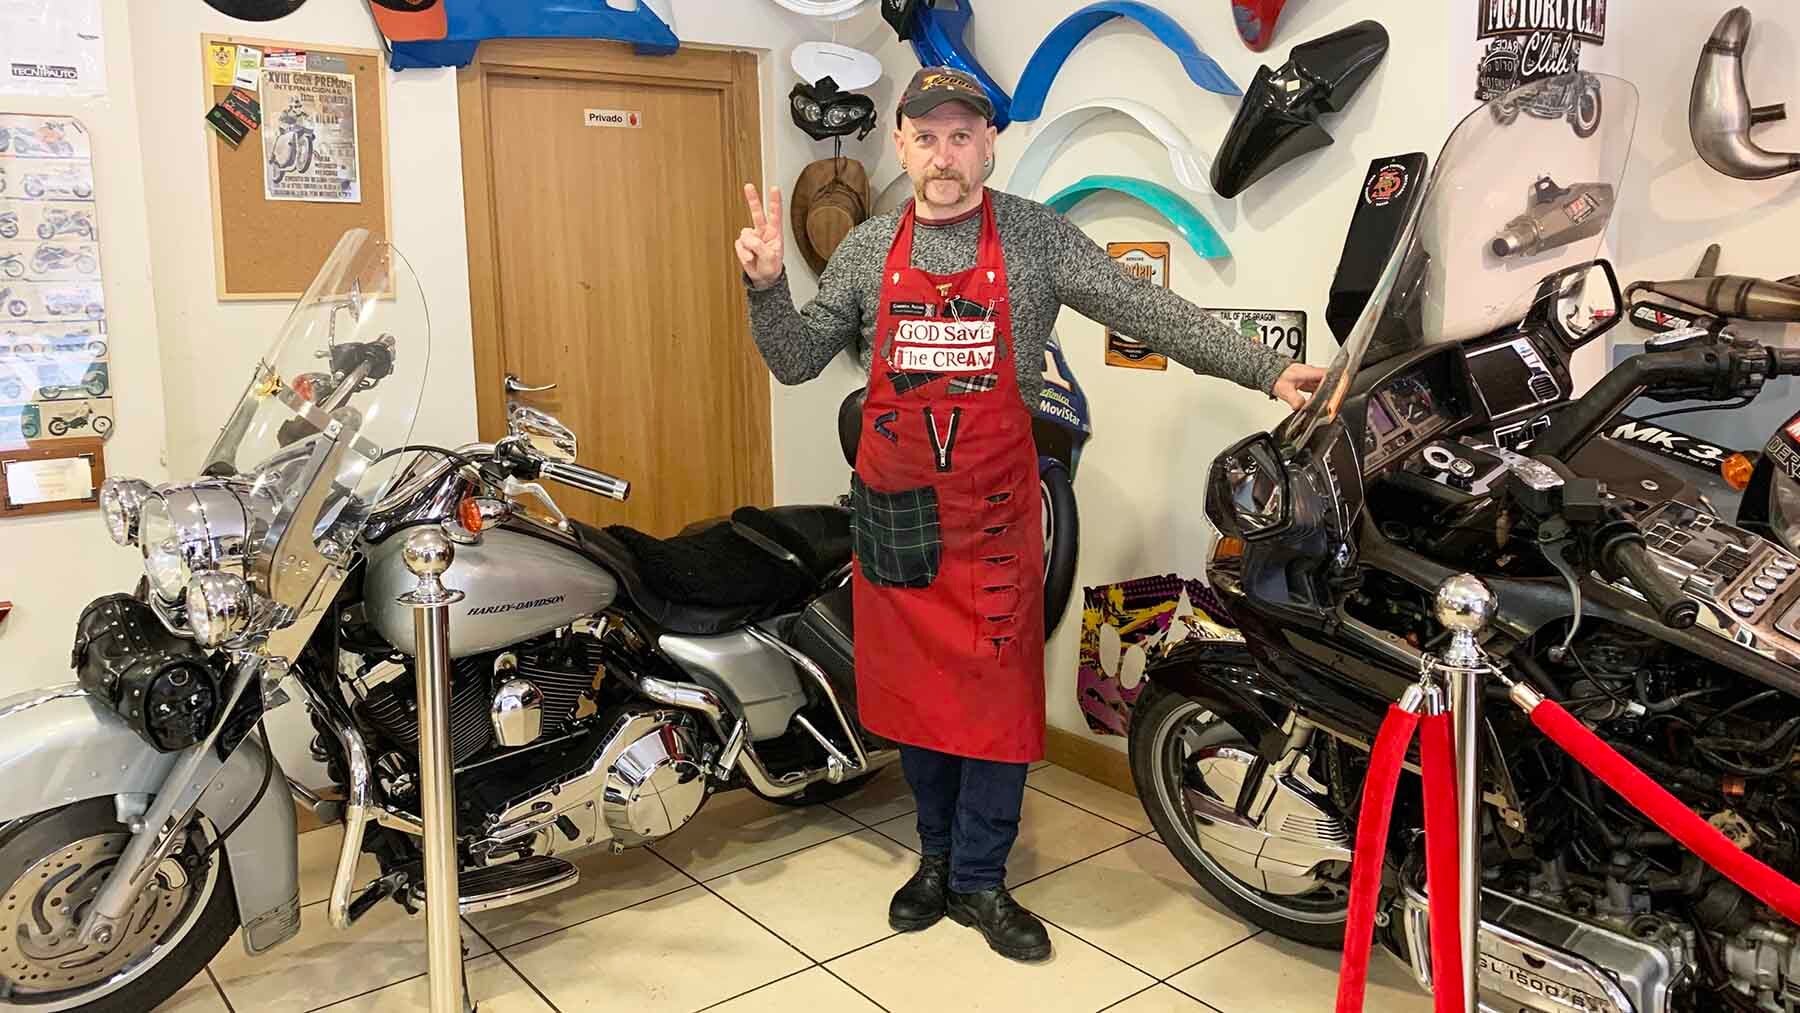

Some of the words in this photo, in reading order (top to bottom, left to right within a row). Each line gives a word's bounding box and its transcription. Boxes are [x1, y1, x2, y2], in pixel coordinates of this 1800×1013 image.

[1487, 0, 1604, 35] MOTORCYCLE
[1521, 31, 1573, 76] Club
[273, 84, 342, 95] INTERNACIONAL
[589, 113, 623, 123] Privado
[900, 323, 940, 341] GOD
[1261, 325, 1302, 359] 129
[1040, 400, 1080, 426] MoviStar
[1610, 421, 1689, 449] MK
[1688, 444, 1725, 462] 3
[467, 594, 566, 615] HARLEY-DAVIDSON
